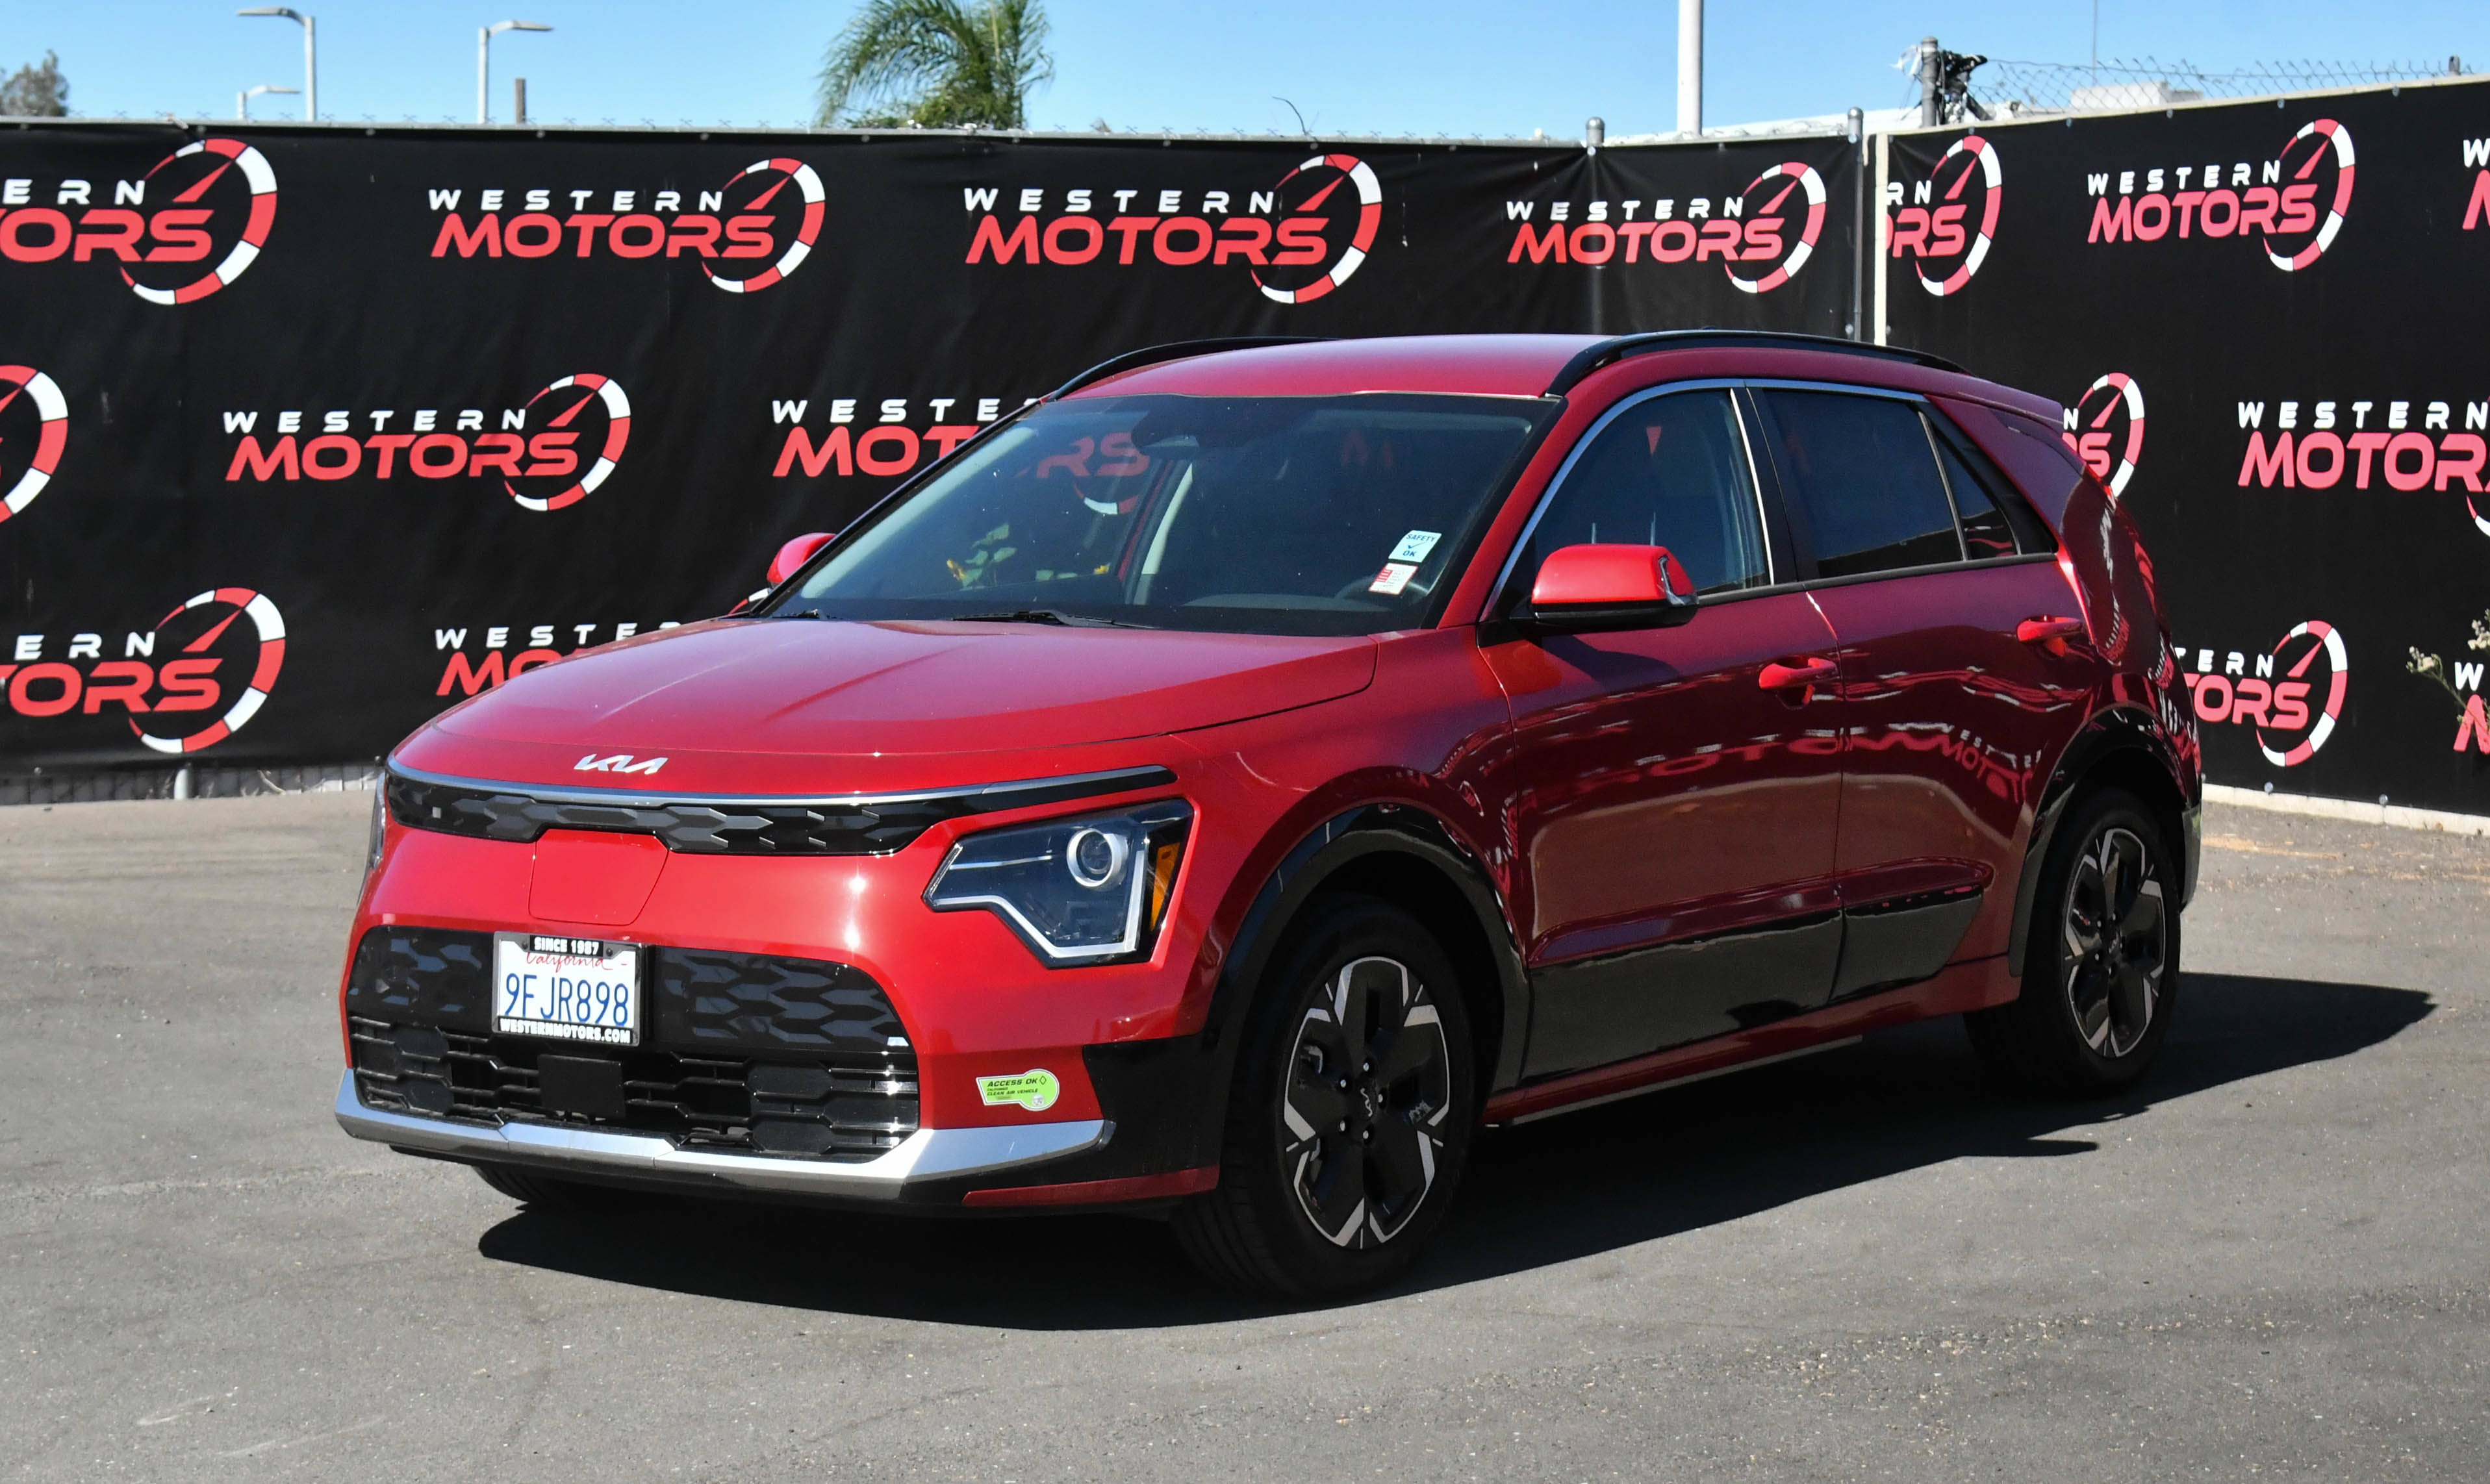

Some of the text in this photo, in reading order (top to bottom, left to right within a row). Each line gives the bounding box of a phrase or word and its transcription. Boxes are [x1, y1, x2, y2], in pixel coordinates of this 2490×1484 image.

[2088, 160, 2280, 195] WESTERN
[429, 189, 722, 211] WESTERN
[965, 188, 1273, 213] WESTERN
[1507, 197, 1743, 221] WESTERN
[2088, 184, 2318, 243] MOTORS
[0, 208, 214, 262] ORS
[431, 213, 776, 258] MOTORS
[966, 215, 1328, 265] MOTORS
[1508, 218, 1785, 264] MOTORS
[1886, 204, 1967, 258] RS
[223, 409, 526, 434] WESTERN
[773, 399, 1036, 423] WESTE
[2239, 401, 2488, 430] WESTERN
[226, 432, 580, 481] MOTORS
[2239, 431, 2490, 493] MOTOR
[436, 622, 680, 649] WESTE
[0, 659, 223, 717] ORS
[534, 937, 599, 955] SINCE 1987
[505, 973, 629, 1027] 9FJR898
[500, 1018, 631, 1044] WESTERNMOTORS.COM
[987, 1079, 1022, 1087] ACCESS
